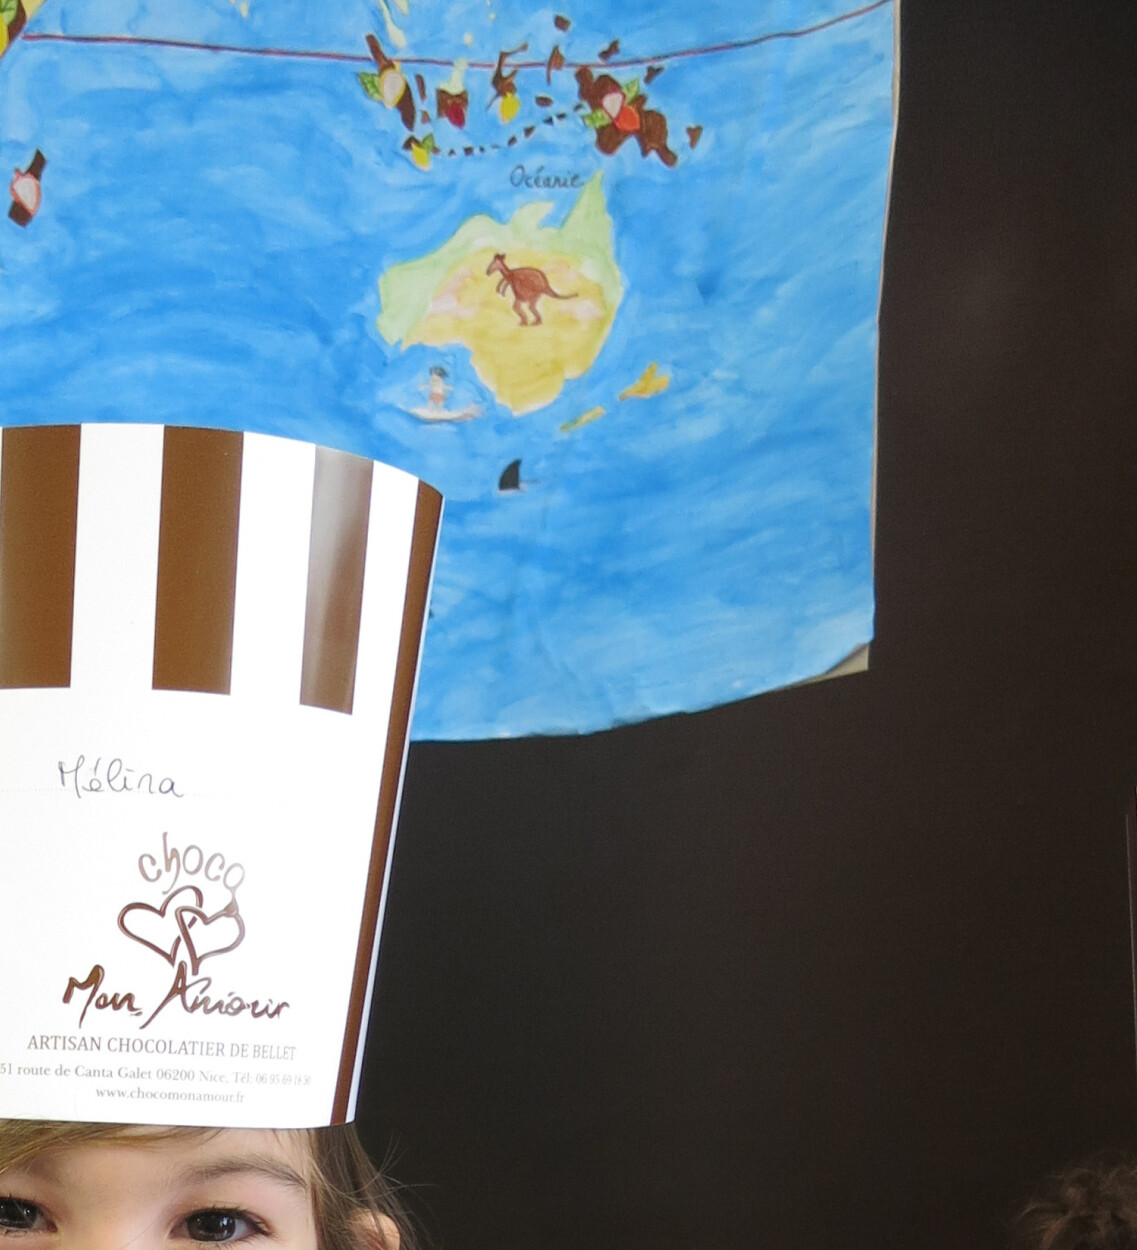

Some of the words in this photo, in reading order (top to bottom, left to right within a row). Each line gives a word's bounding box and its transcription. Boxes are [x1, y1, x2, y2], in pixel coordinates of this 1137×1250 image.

[509, 164, 584, 189] Océanie
[58, 754, 184, 799] Mélina
[139, 960, 291, 1030] Amour
[27, 1034, 103, 1052] ARTISAN
[107, 1037, 226, 1058] CHOCOLATIER
[230, 1042, 250, 1059] DE
[252, 1044, 297, 1061] BELLET
[17, 1064, 52, 1077] route
[55, 1064, 72, 1077] de
[74, 1064, 114, 1079] Canta
[118, 1066, 153, 1080] Galet
[156, 1068, 196, 1082] 06200
[255, 1072, 268, 1085] 06
[95, 1086, 246, 1104] www.chocomonamour.fr
